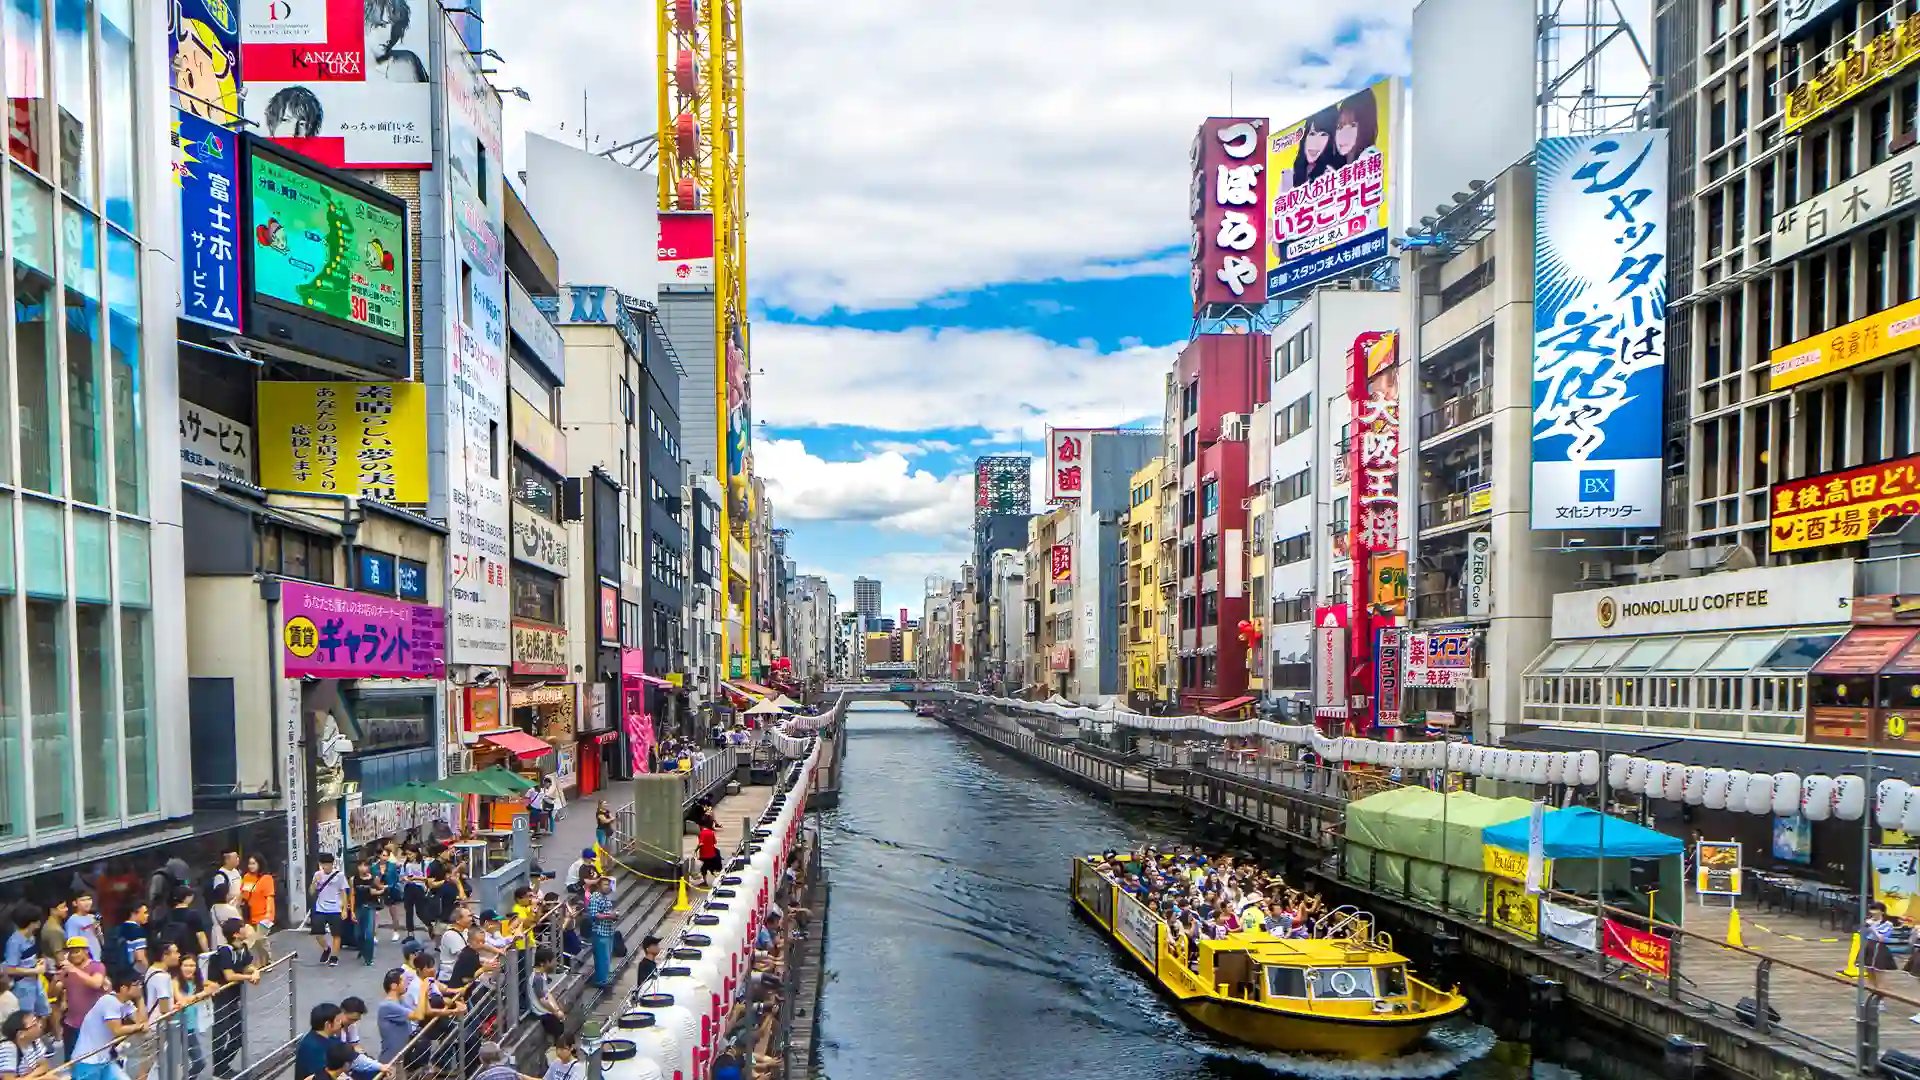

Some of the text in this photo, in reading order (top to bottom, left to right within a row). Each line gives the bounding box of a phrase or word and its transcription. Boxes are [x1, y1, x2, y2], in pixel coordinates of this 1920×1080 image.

[291, 48, 360, 68] KANZAKI
[318, 61, 360, 80] RUKA
[340, 121, 415, 133] めっちゃ面白いを
[1274, 152, 1382, 216] 高収入お仕事情報
[1776, 160, 1917, 245] 4F 白木屋
[1216, 119, 1264, 297] つぼらや
[1273, 181, 1382, 242] いちごナビ
[207, 171, 234, 322] 富士ホーム
[1327, 226, 1344, 244] 求人
[189, 230, 208, 309] サービス
[351, 295, 367, 322] 30
[290, 423, 312, 482] 応援します
[315, 387, 338, 490] あなたのお店づくり
[1359, 392, 1399, 549] 大阪王将
[1584, 477, 1610, 493] BX
[1796, 508, 1864, 543] 酒場
[1622, 589, 1769, 617] HONOLULU COFFEE
[289, 624, 315, 649] 賃貸
[319, 616, 411, 665] ギャラント
[1426, 669, 1451, 685] 免税
